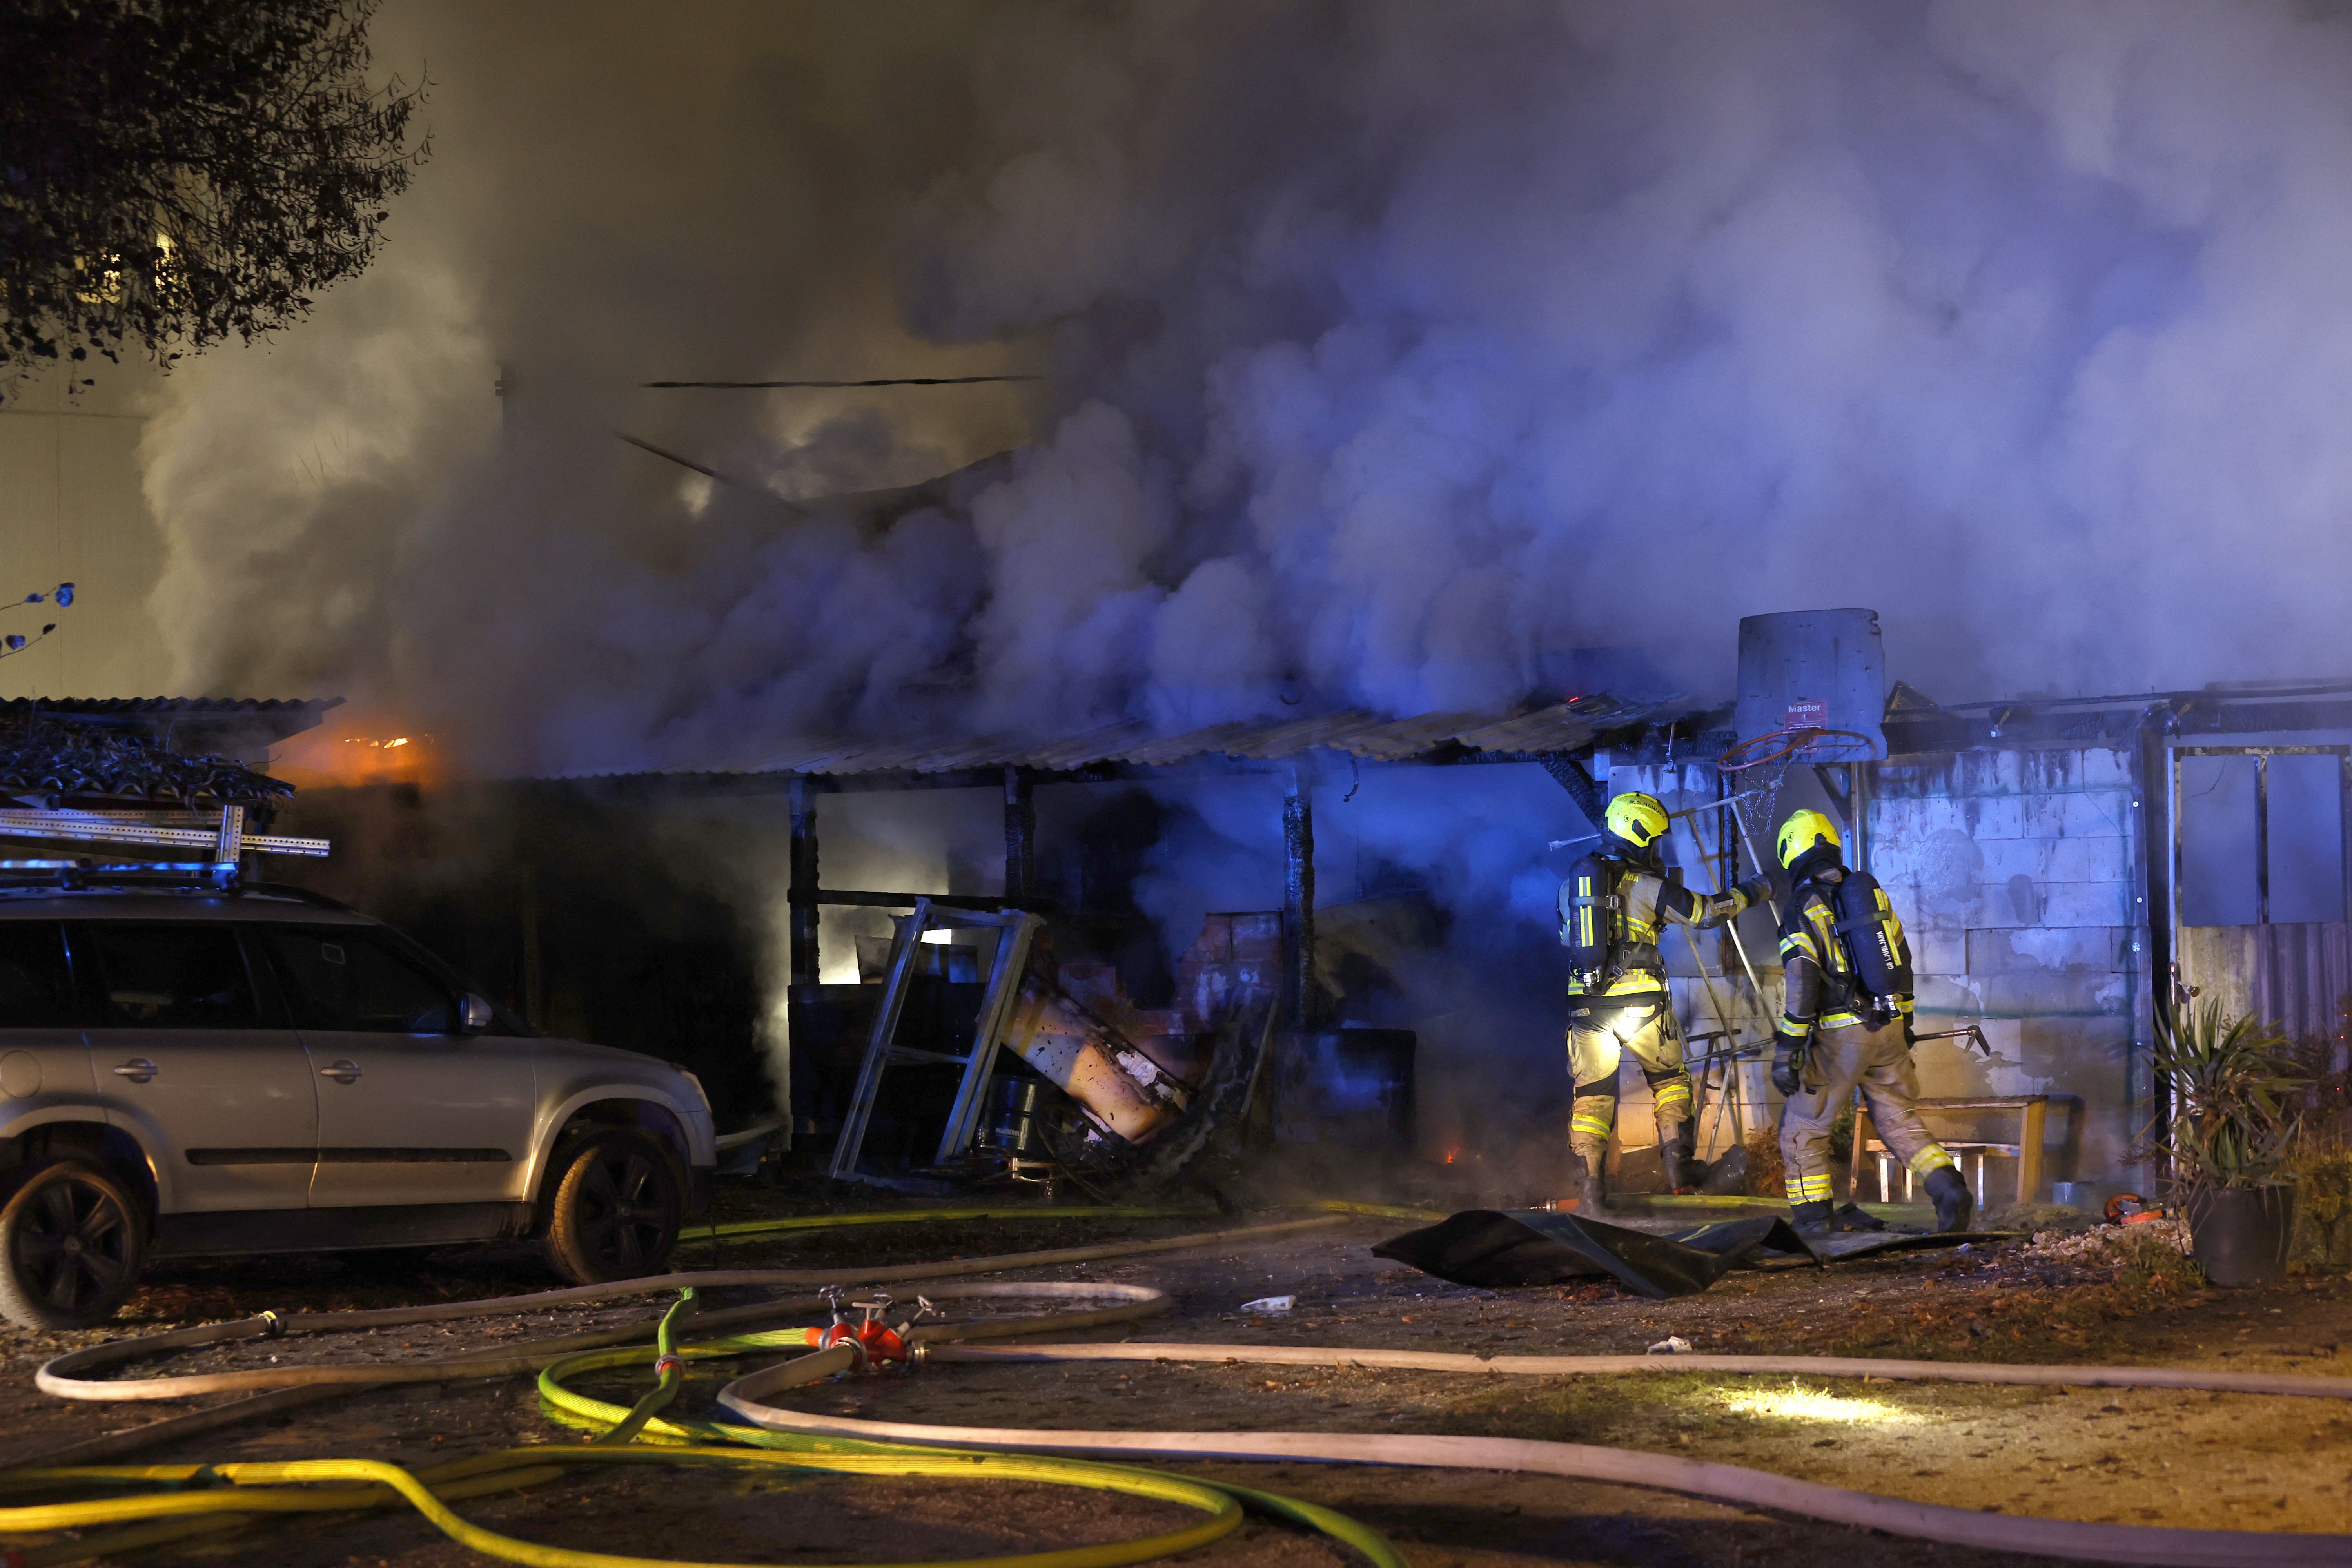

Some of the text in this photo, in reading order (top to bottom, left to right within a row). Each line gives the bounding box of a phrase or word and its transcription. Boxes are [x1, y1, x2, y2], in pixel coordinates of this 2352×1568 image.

[1788, 704, 1821, 713] Master
[1876, 931, 1894, 970] GB LJUBLJANA
